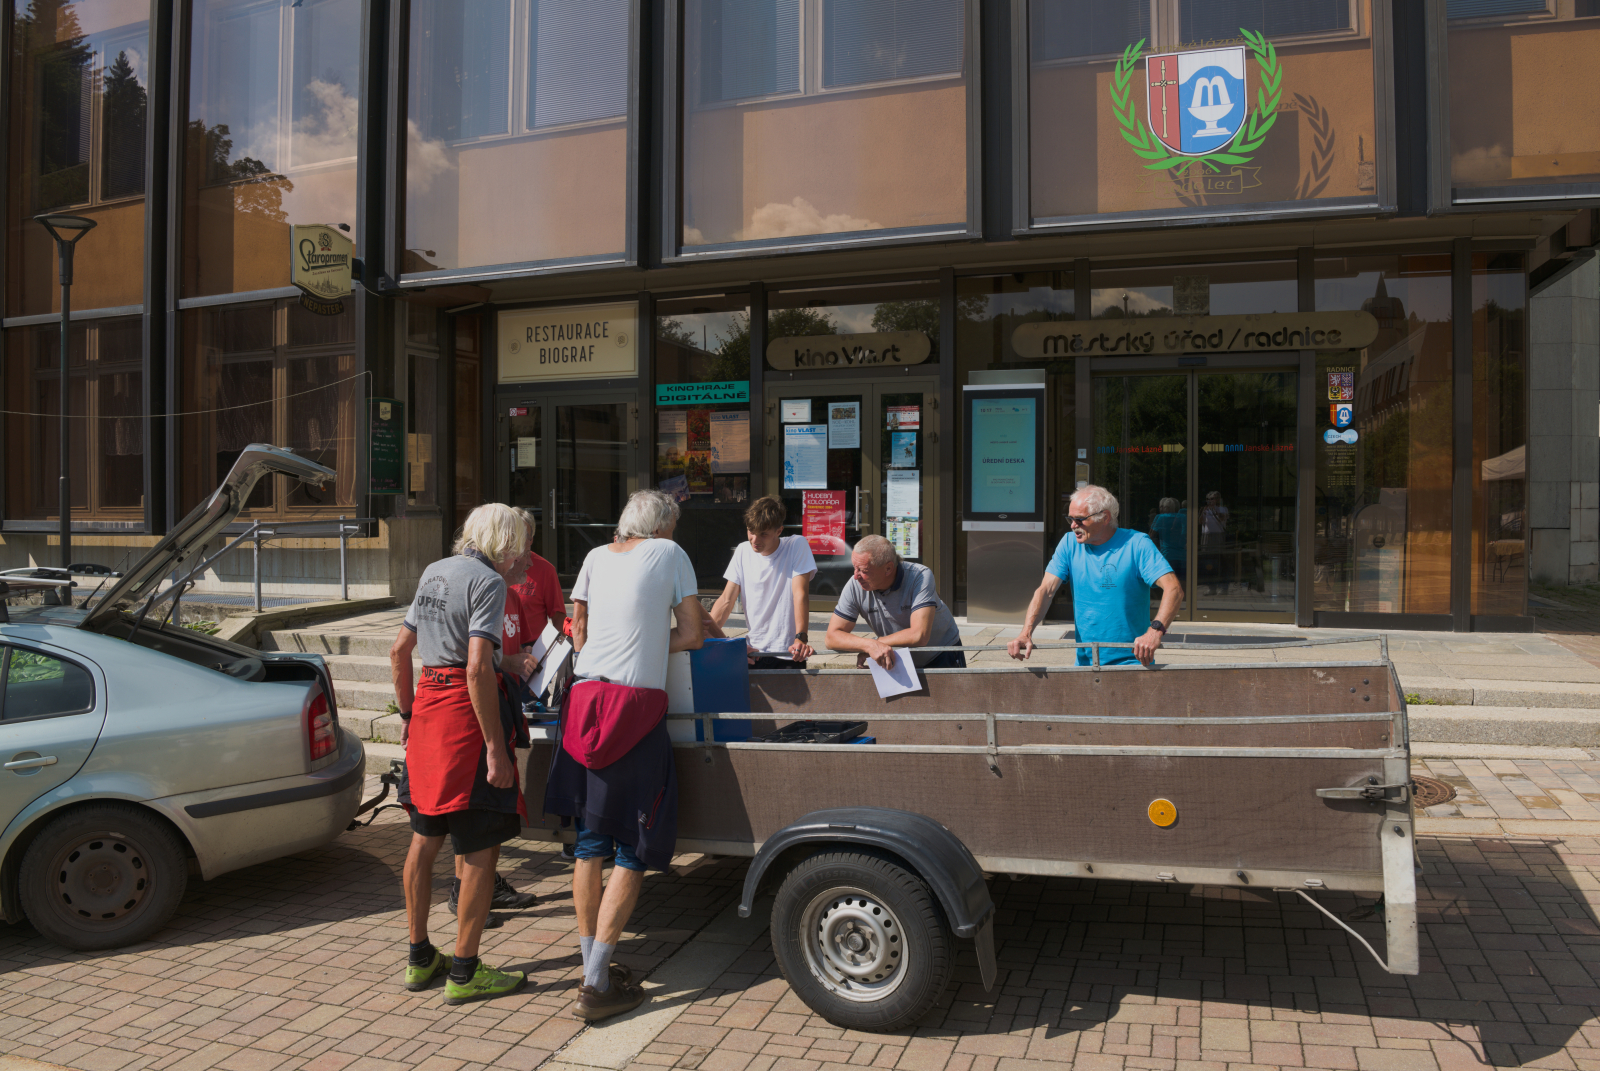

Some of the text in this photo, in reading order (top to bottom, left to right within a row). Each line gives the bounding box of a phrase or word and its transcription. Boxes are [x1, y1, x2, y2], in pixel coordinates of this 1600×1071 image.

[1183, 167, 1213, 177] 2006
[1162, 181, 1205, 195] 1000
[299, 239, 350, 272] Staropramen
[303, 296, 341, 315] NEPASTER
[526, 321, 609, 343] RESTAURACE
[539, 345, 595, 365] BIOGRAF
[794, 348, 839, 367] kino
[696, 383, 735, 391] HRAJE
[658, 391, 747, 402] DIGITÁLNĚ
[1141, 444, 1163, 453] Lázně
[1244, 443, 1294, 452] Janské Lázně
